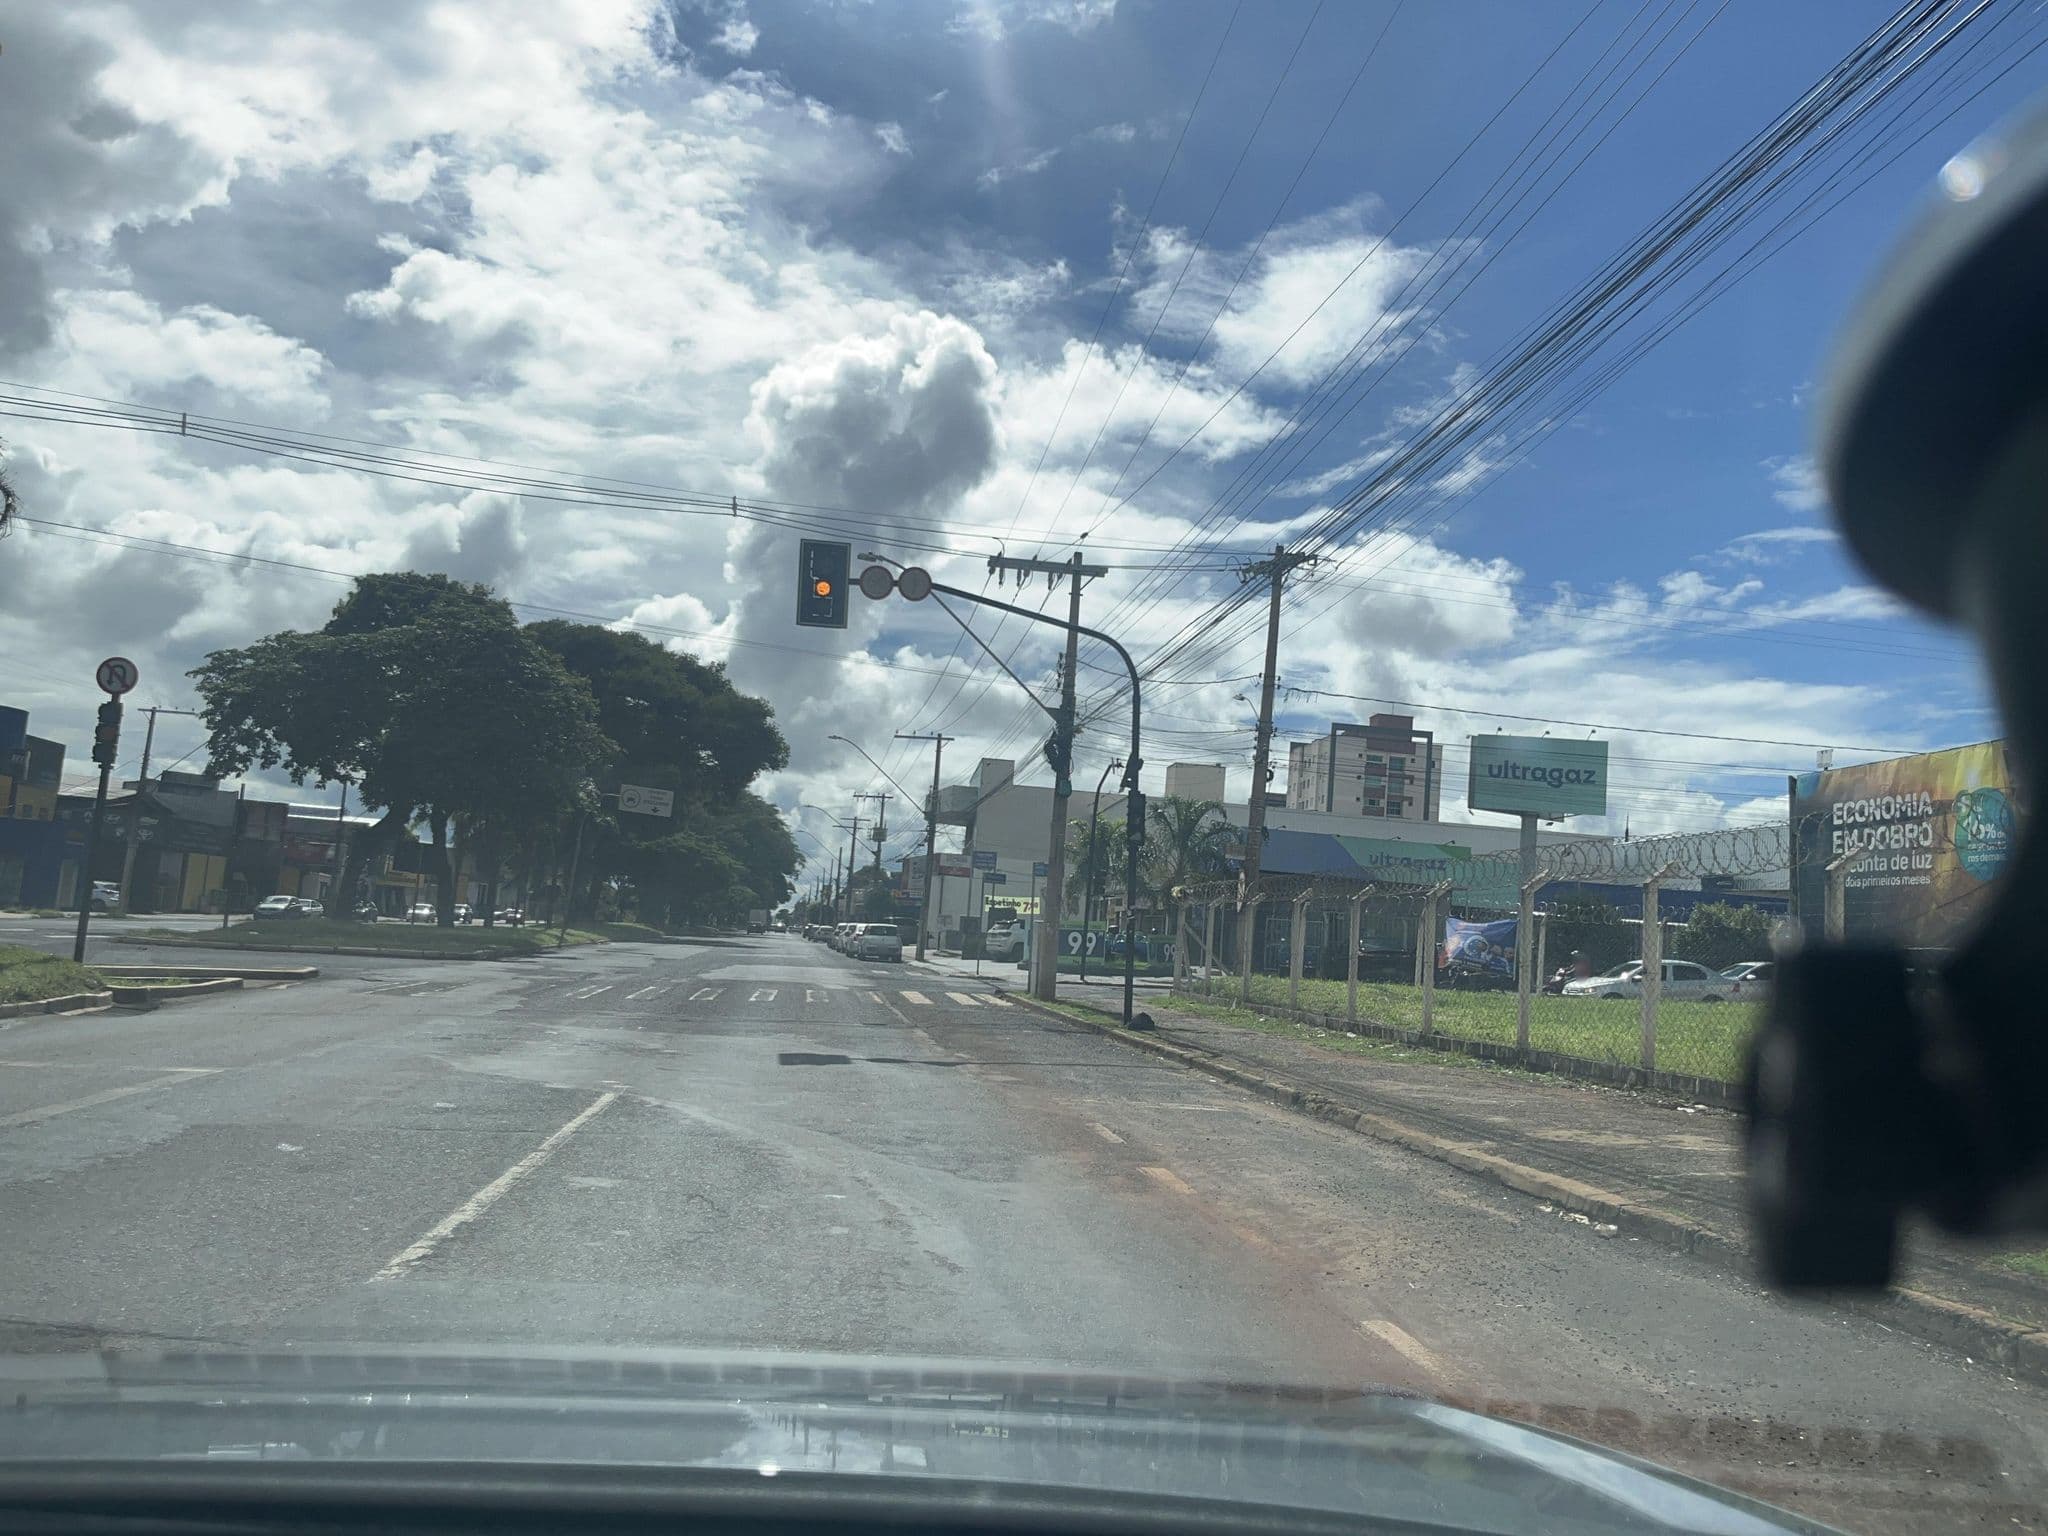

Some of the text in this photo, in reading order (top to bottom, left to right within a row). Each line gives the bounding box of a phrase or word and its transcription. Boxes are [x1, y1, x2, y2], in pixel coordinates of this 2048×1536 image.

[1487, 760, 1596, 788] ultragaz
[1833, 791, 1932, 825] ECONOMIA
[1863, 821, 1933, 850] DOBRO
[1891, 854, 1908, 870] de
[1912, 850, 1932, 869] luz
[1862, 875, 1900, 889] primeiros
[1901, 875, 1931, 885] meses
[1068, 931, 1096, 955] 99
